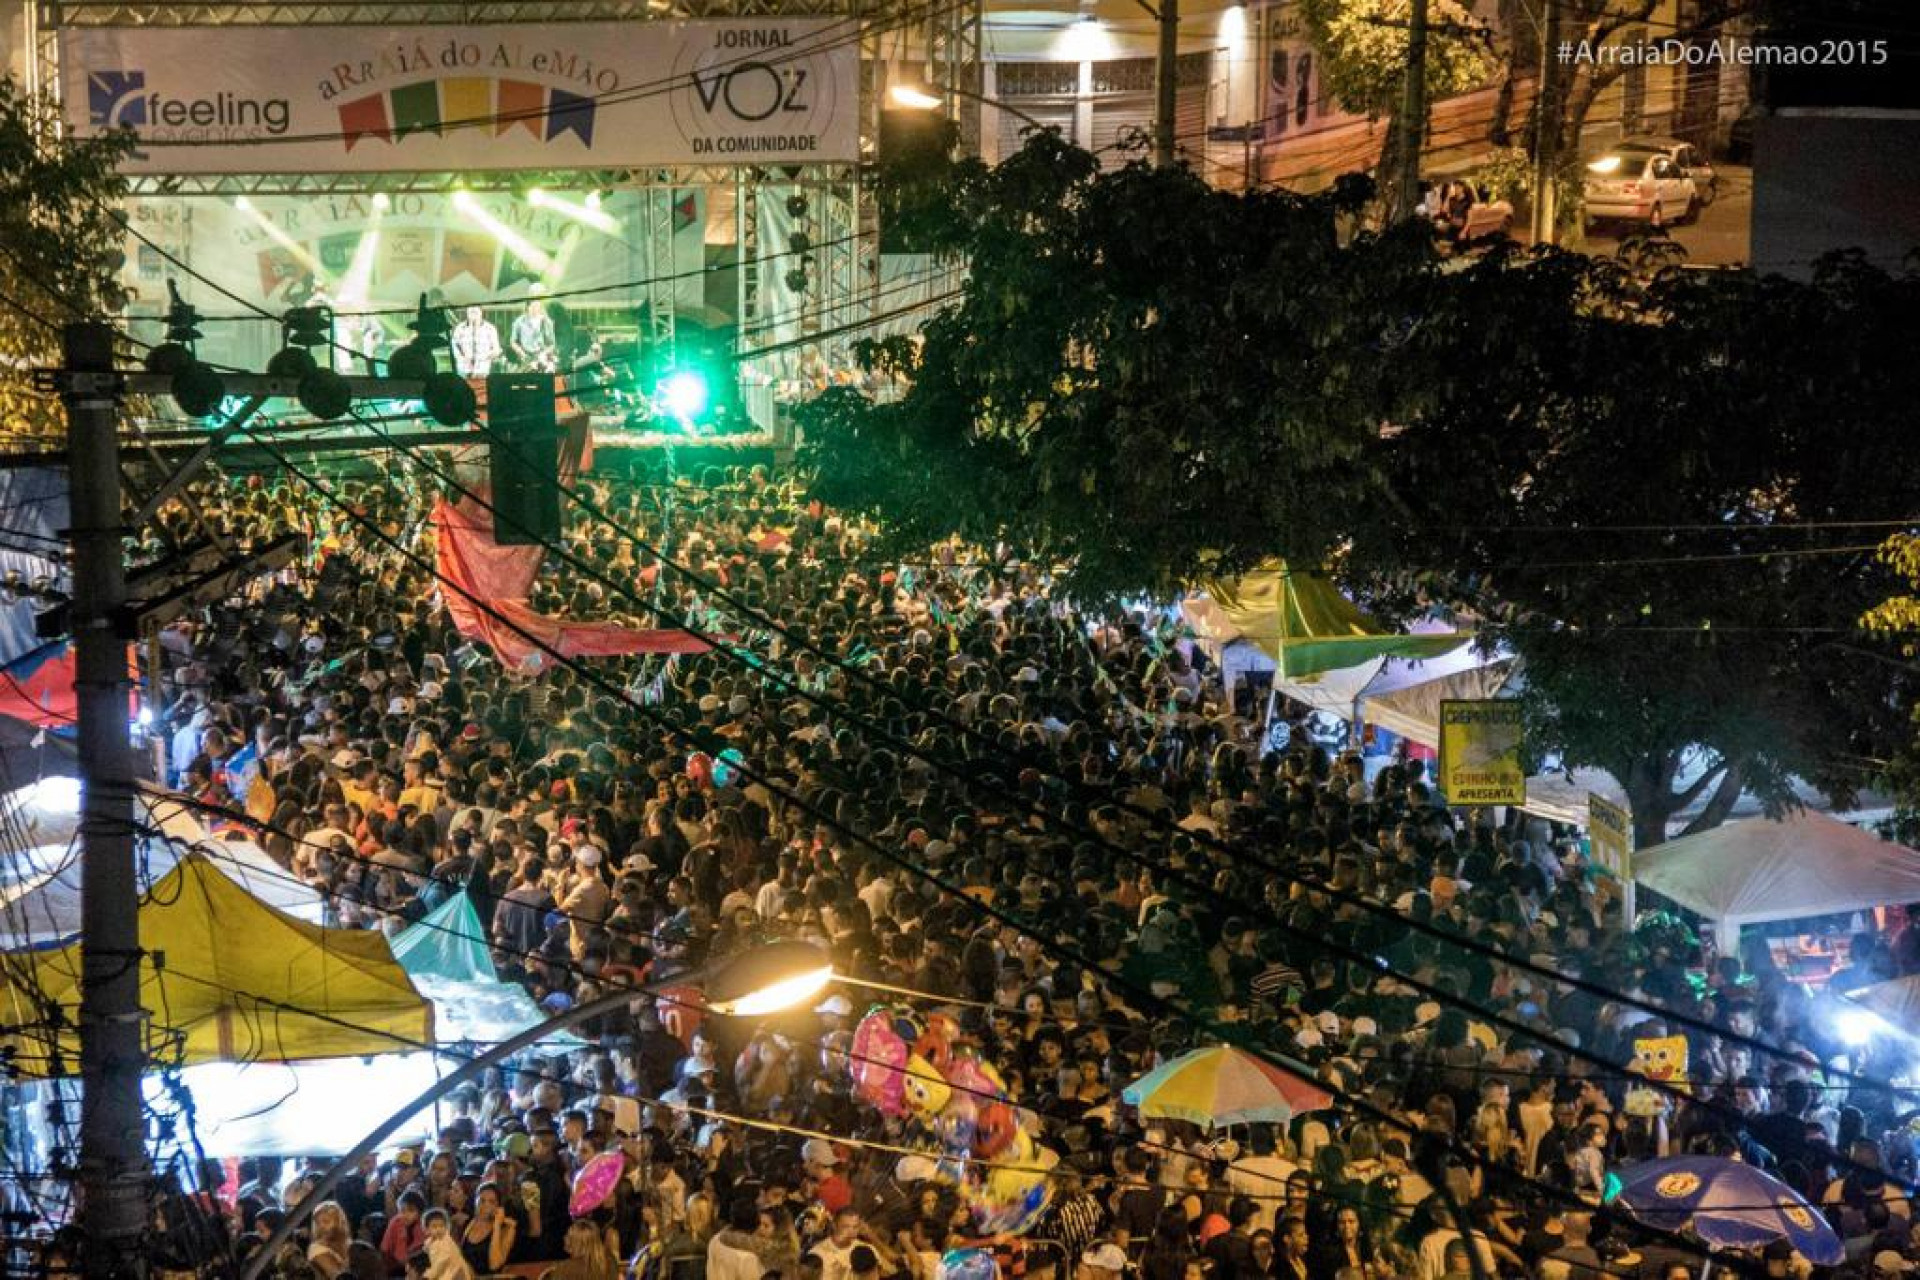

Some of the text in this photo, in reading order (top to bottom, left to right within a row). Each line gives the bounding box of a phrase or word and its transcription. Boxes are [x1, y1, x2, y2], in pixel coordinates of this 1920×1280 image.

[714, 29, 794, 48] JORNAL
[689, 61, 809, 122] VOZ
[148, 91, 290, 134] feeling
[692, 134, 818, 153] DA COMUNIDADE
[1457, 787, 1515, 799] APRESENTA
